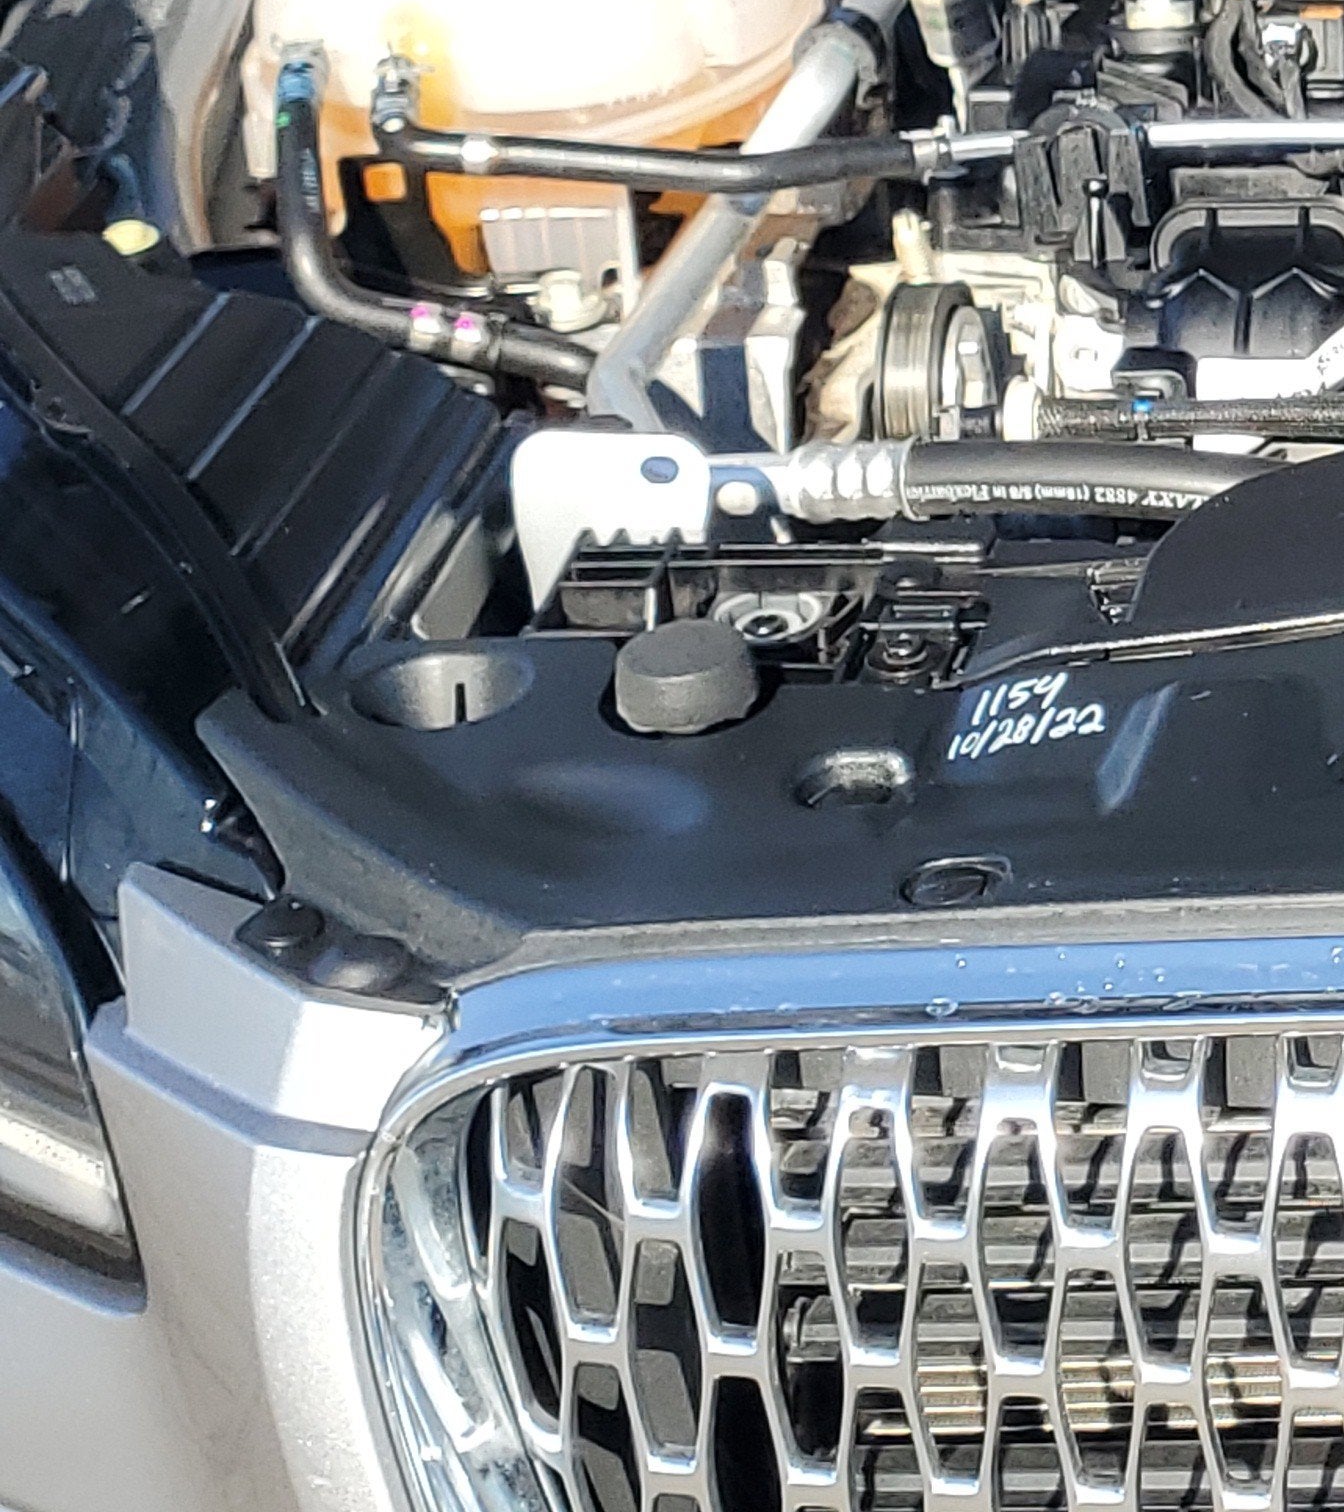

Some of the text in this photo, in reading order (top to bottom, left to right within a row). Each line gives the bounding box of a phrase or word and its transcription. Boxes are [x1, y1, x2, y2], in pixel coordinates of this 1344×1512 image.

[992, 484, 1007, 500] in
[1141, 489, 1211, 511] LAXY
[971, 672, 1069, 726] 1154
[947, 703, 1106, 761] 10/28/22
